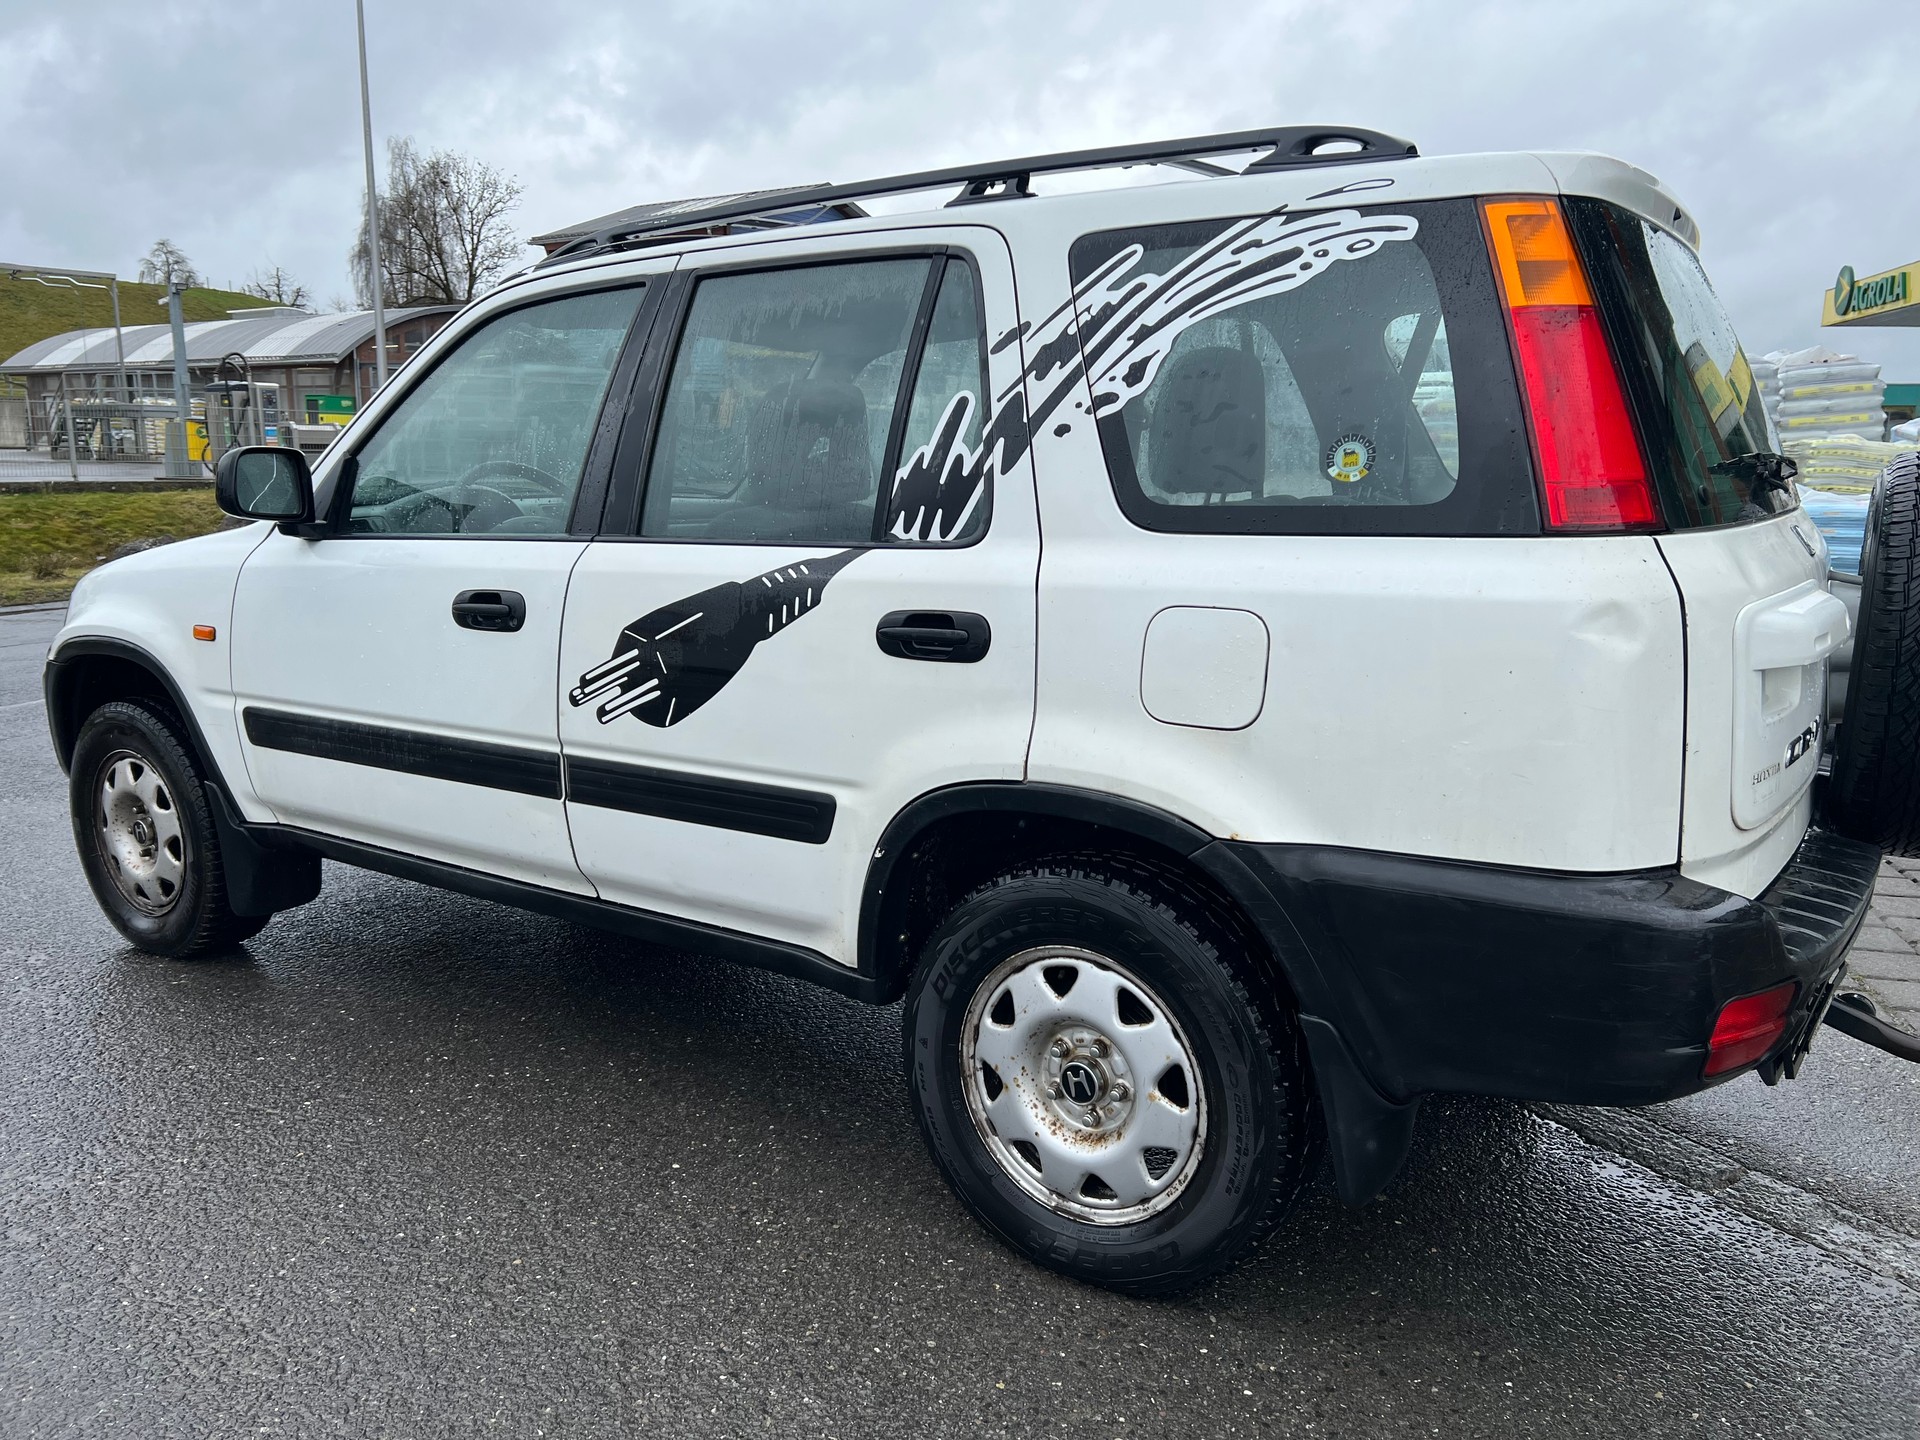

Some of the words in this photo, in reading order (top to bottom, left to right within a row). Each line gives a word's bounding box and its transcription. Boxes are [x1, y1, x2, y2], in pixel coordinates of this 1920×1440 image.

[1850, 271, 1907, 312] AGROLA
[1343, 459, 1358, 468] eni
[1752, 762, 1781, 785] HONDA
